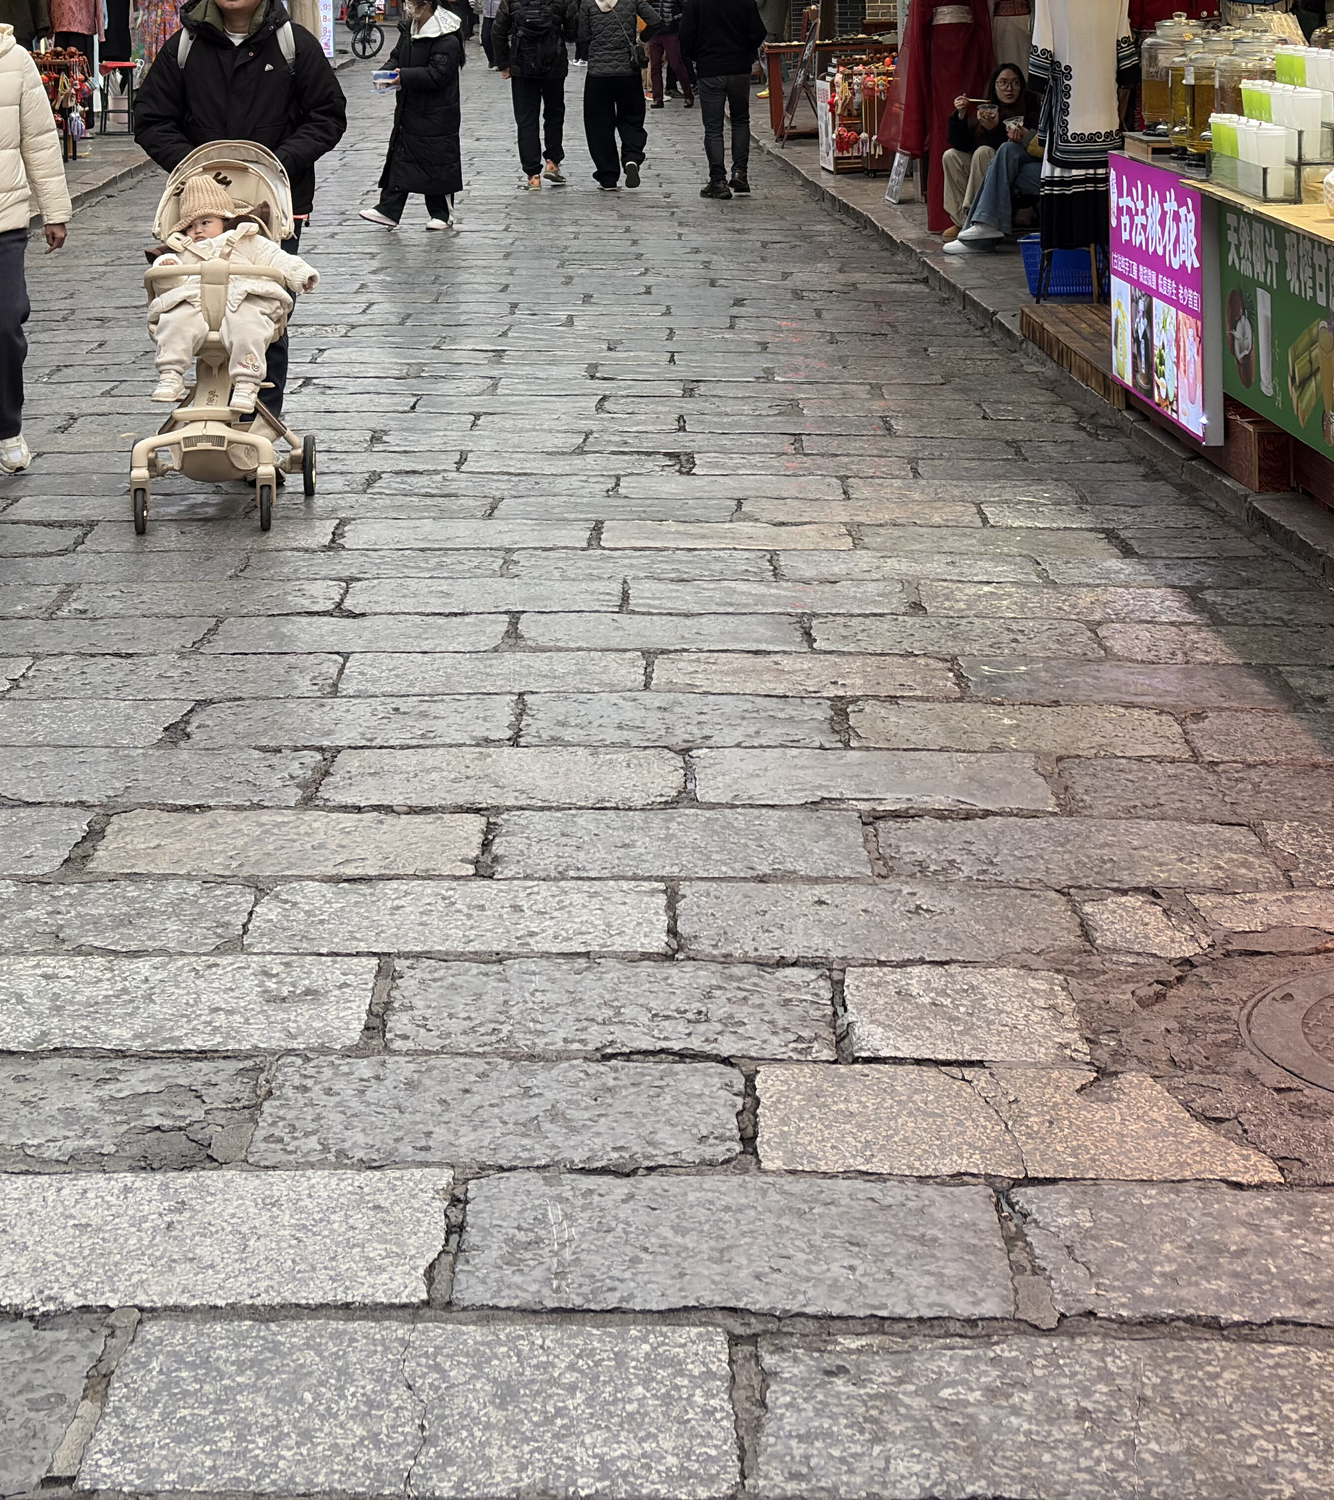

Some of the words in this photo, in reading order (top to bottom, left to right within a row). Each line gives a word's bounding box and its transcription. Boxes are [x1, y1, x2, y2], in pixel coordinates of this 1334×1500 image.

[1118, 174, 1200, 274] 古法桃花酿
[1225, 212, 1279, 289] 天然椰汁
